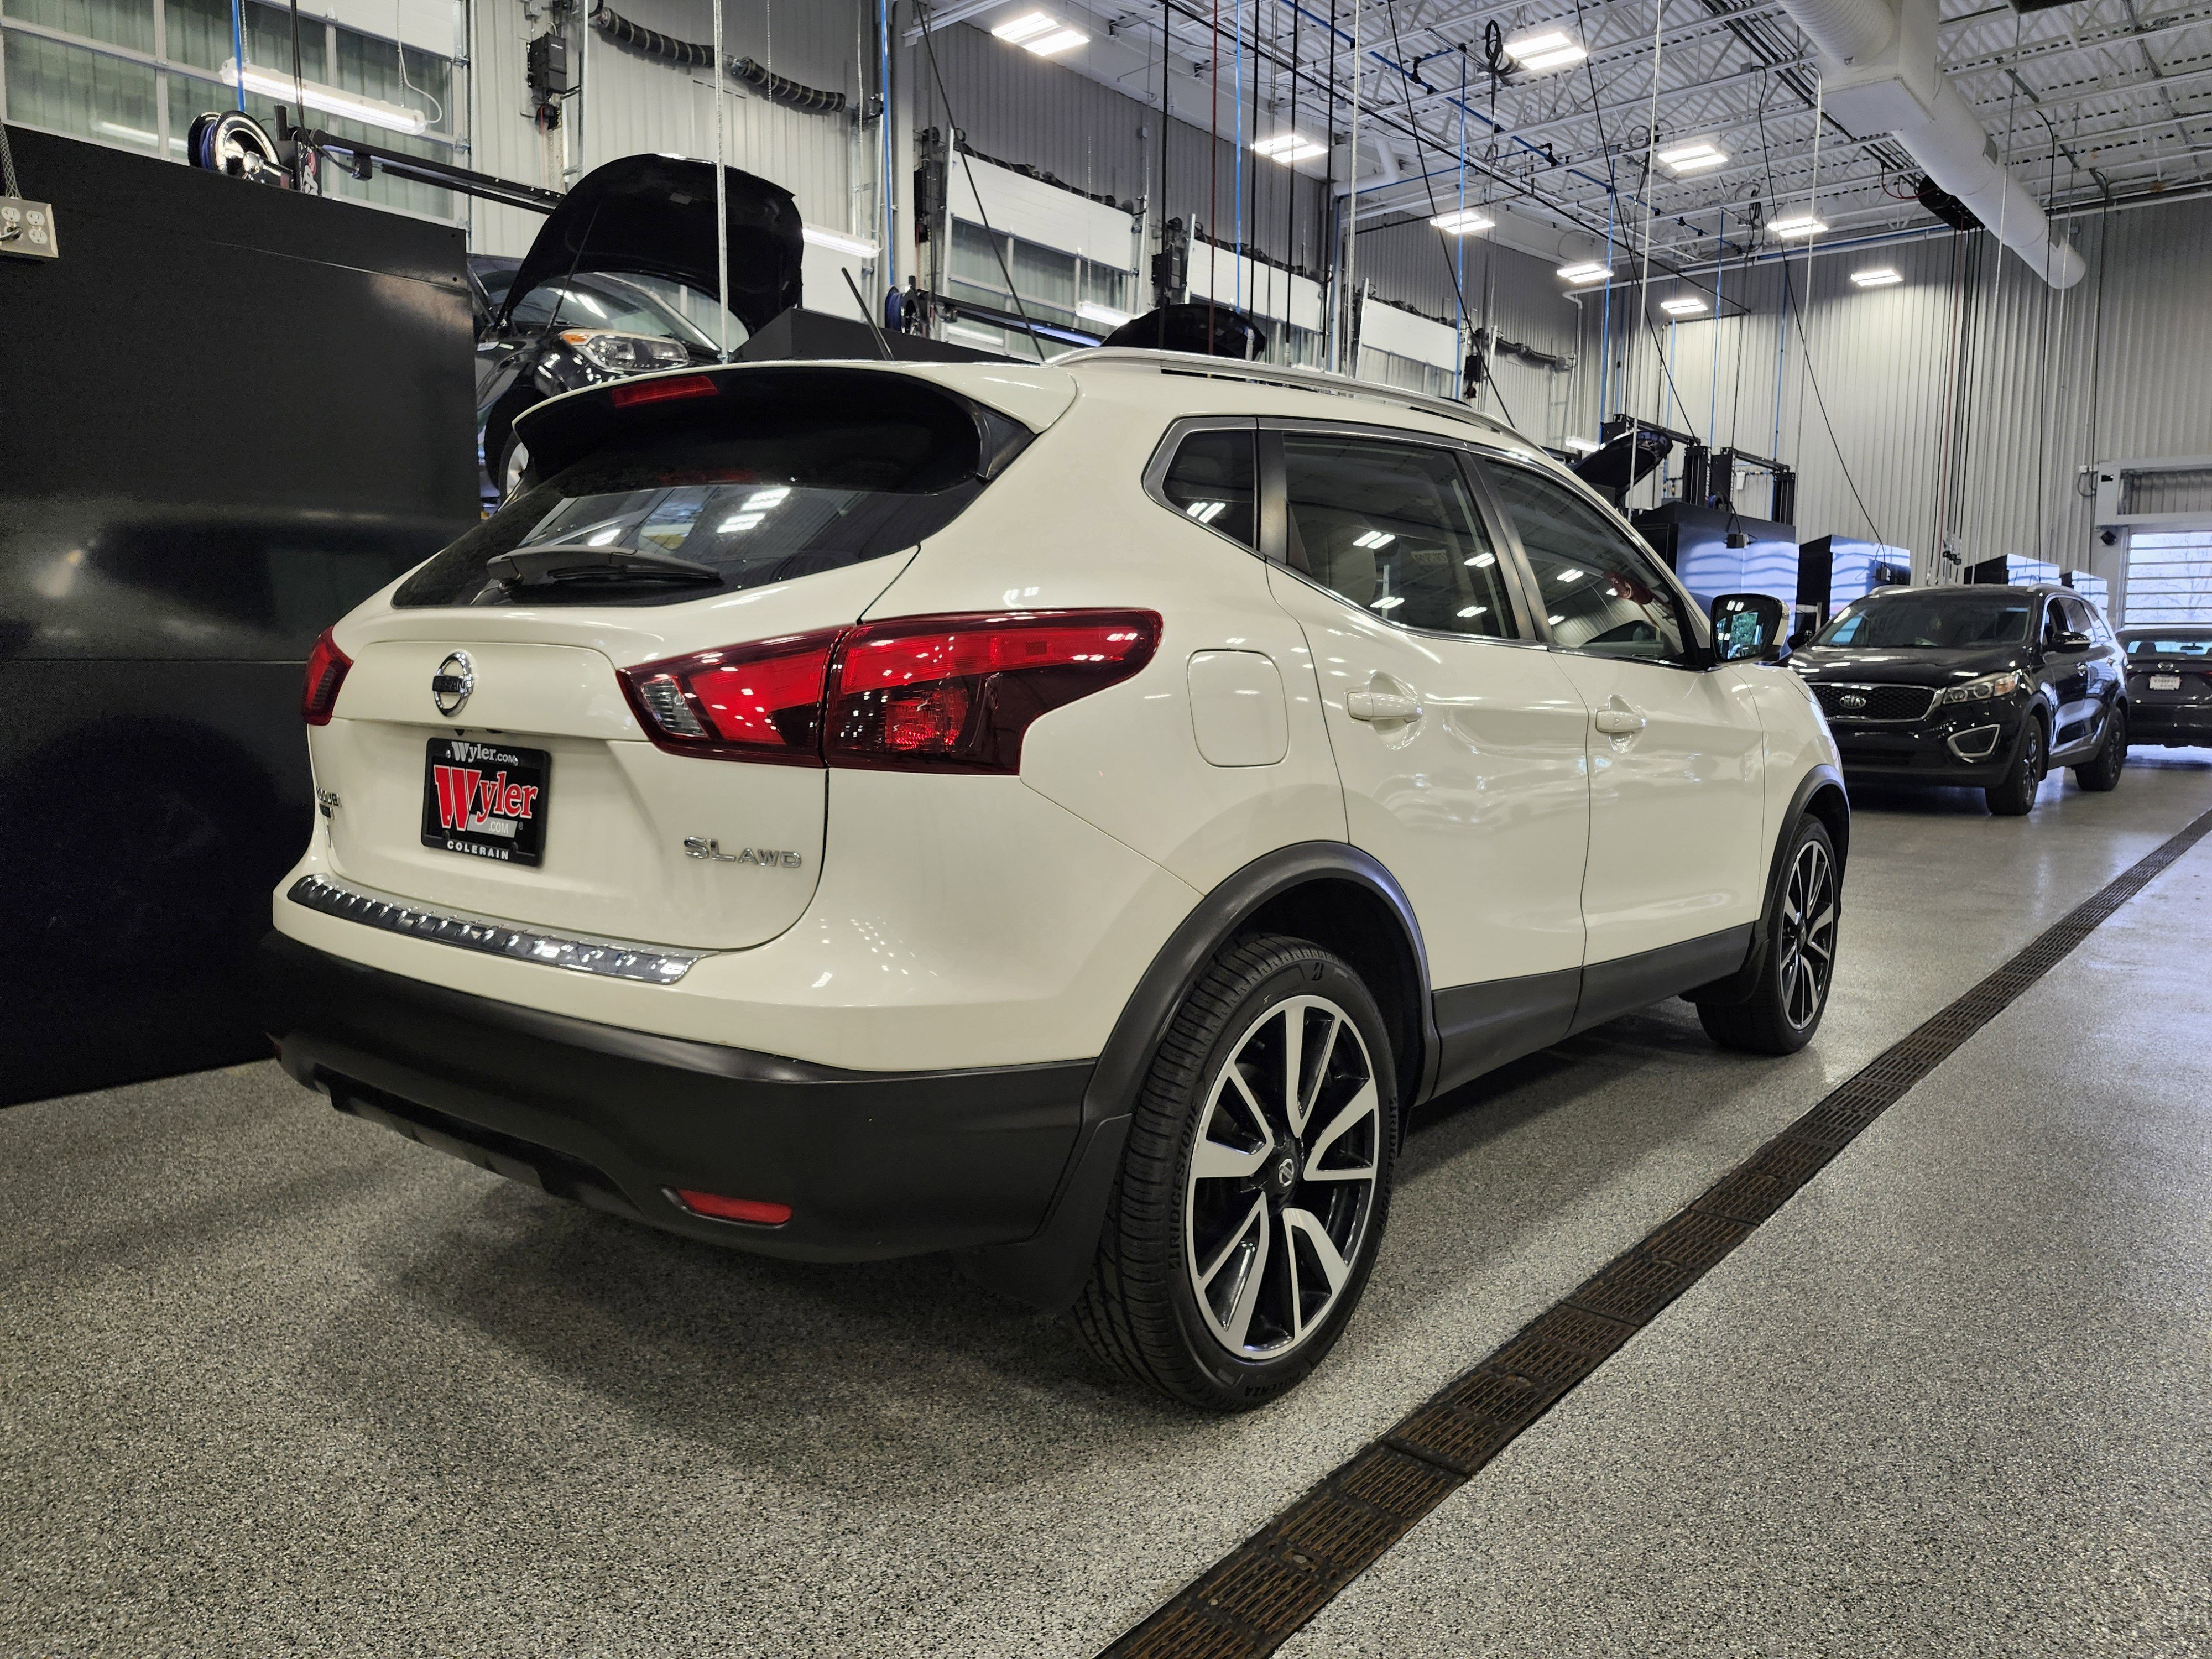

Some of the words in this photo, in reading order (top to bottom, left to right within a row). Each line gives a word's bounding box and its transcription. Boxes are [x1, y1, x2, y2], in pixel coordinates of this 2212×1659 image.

[434, 764, 538, 831] Wyler
[488, 821, 508, 834] .COM
[447, 840, 508, 860] COLERAIN
[684, 836, 736, 862] SL
[738, 847, 802, 868] AWD
